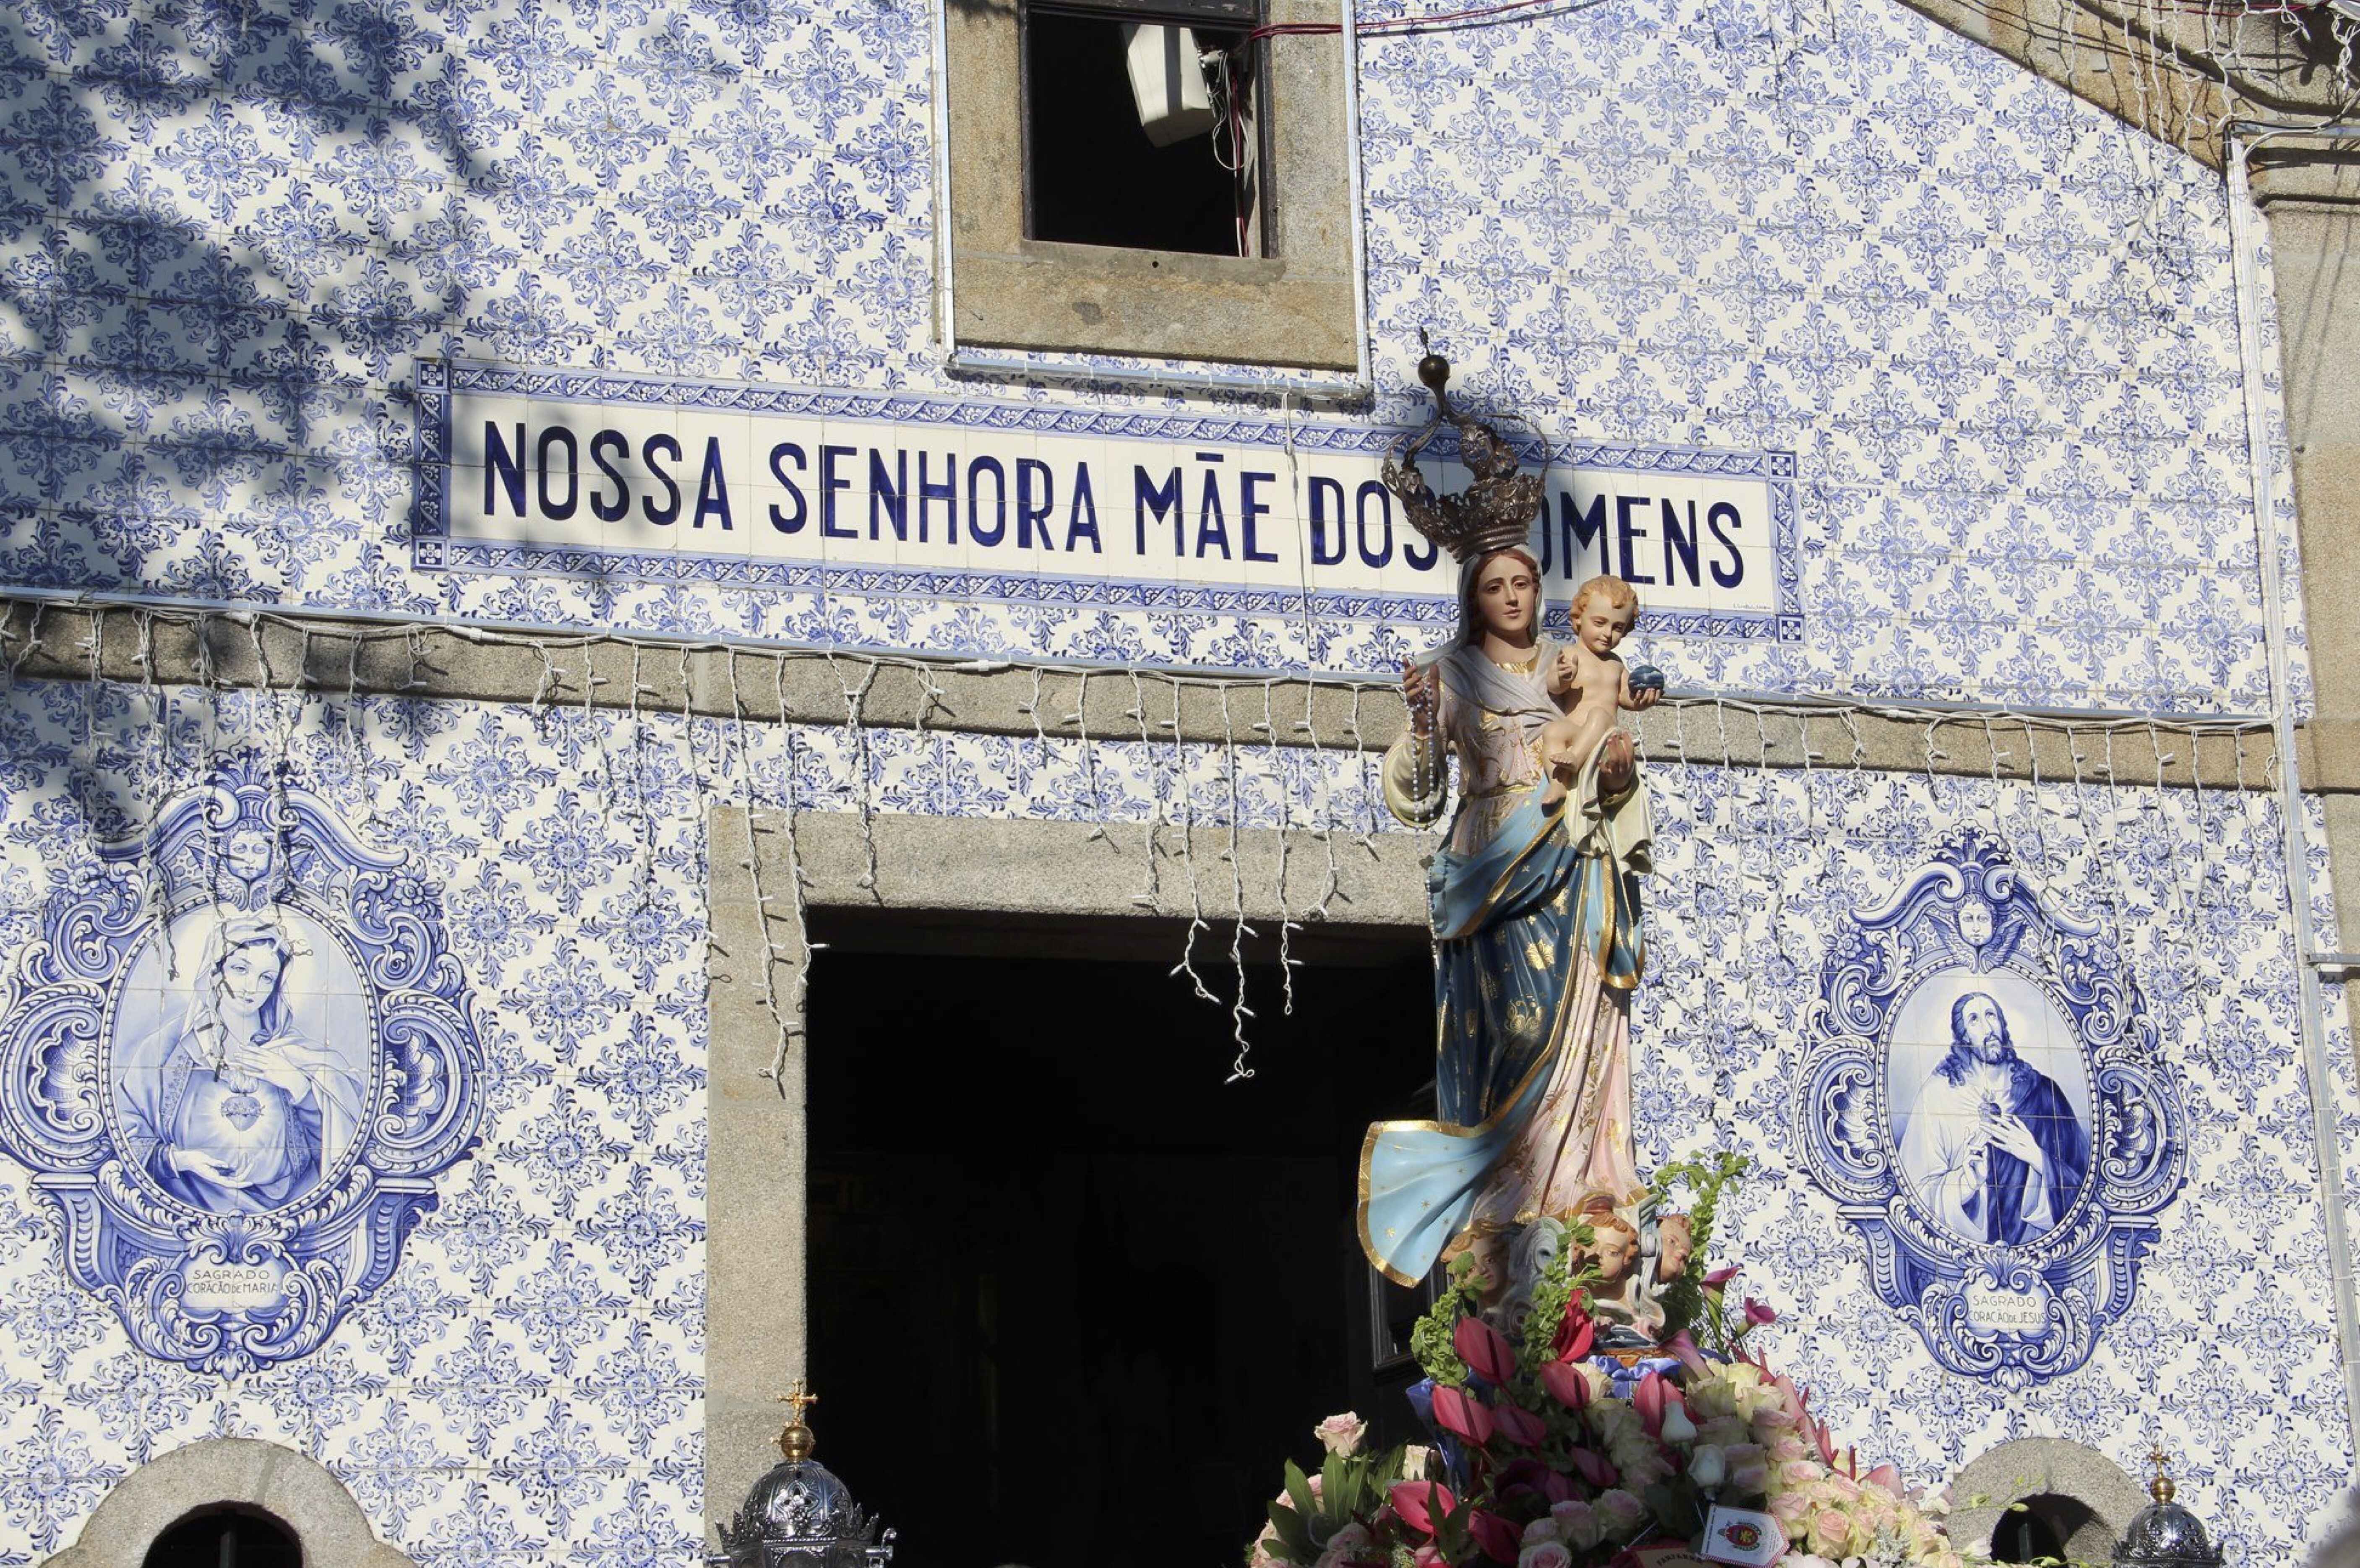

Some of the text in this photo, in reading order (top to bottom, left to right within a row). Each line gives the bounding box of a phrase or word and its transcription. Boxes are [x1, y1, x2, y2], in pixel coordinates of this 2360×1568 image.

[484, 420, 733, 531] NOSSA
[769, 443, 1103, 554] SENHORA
[193, 1270, 271, 1280] SAGRADO
[243, 1282, 277, 1293] MARIA
[1972, 1295, 2036, 1308] SAGRADO
[2018, 1311, 2045, 1324] JESUS
